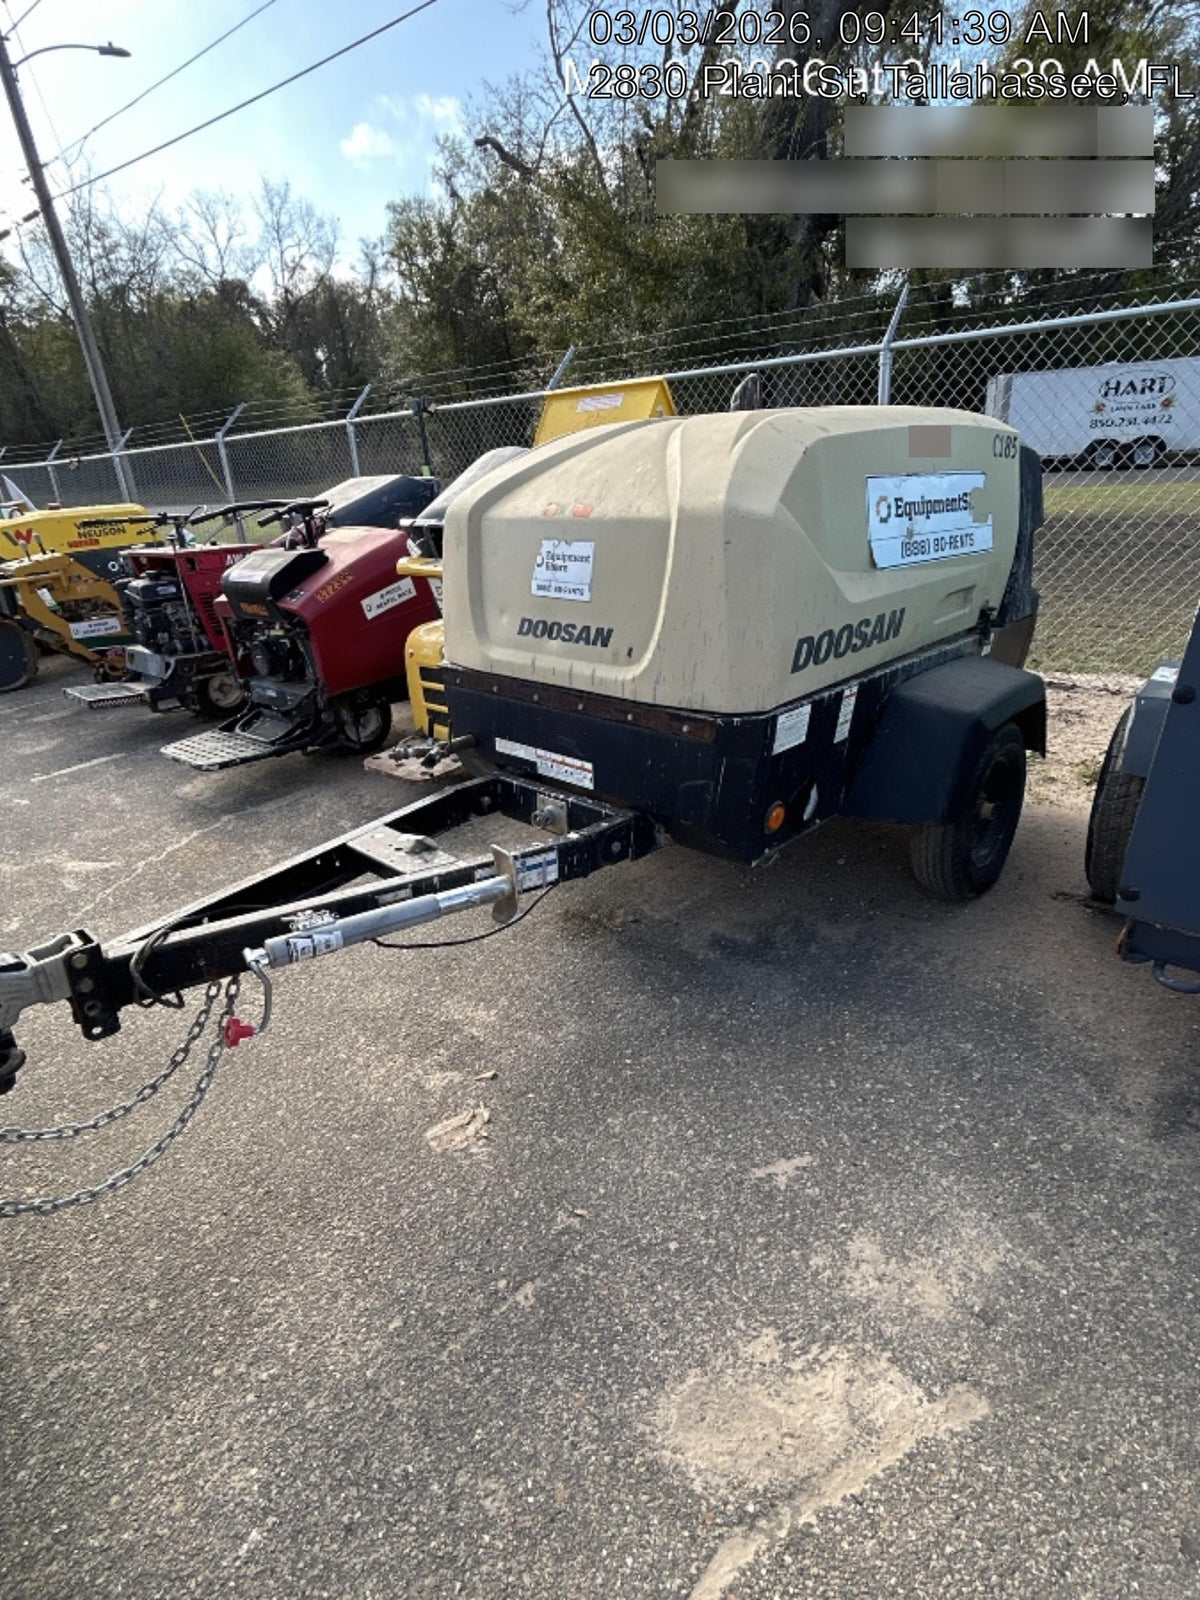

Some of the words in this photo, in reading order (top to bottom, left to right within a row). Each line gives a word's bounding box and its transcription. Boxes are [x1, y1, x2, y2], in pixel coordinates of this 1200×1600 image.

[1103, 377, 1167, 398] HART
[992, 433, 1018, 459] C185
[77, 526, 126, 539] NEUSON
[517, 616, 614, 648] DOOSAN
[790, 606, 906, 675] DOOSAN
